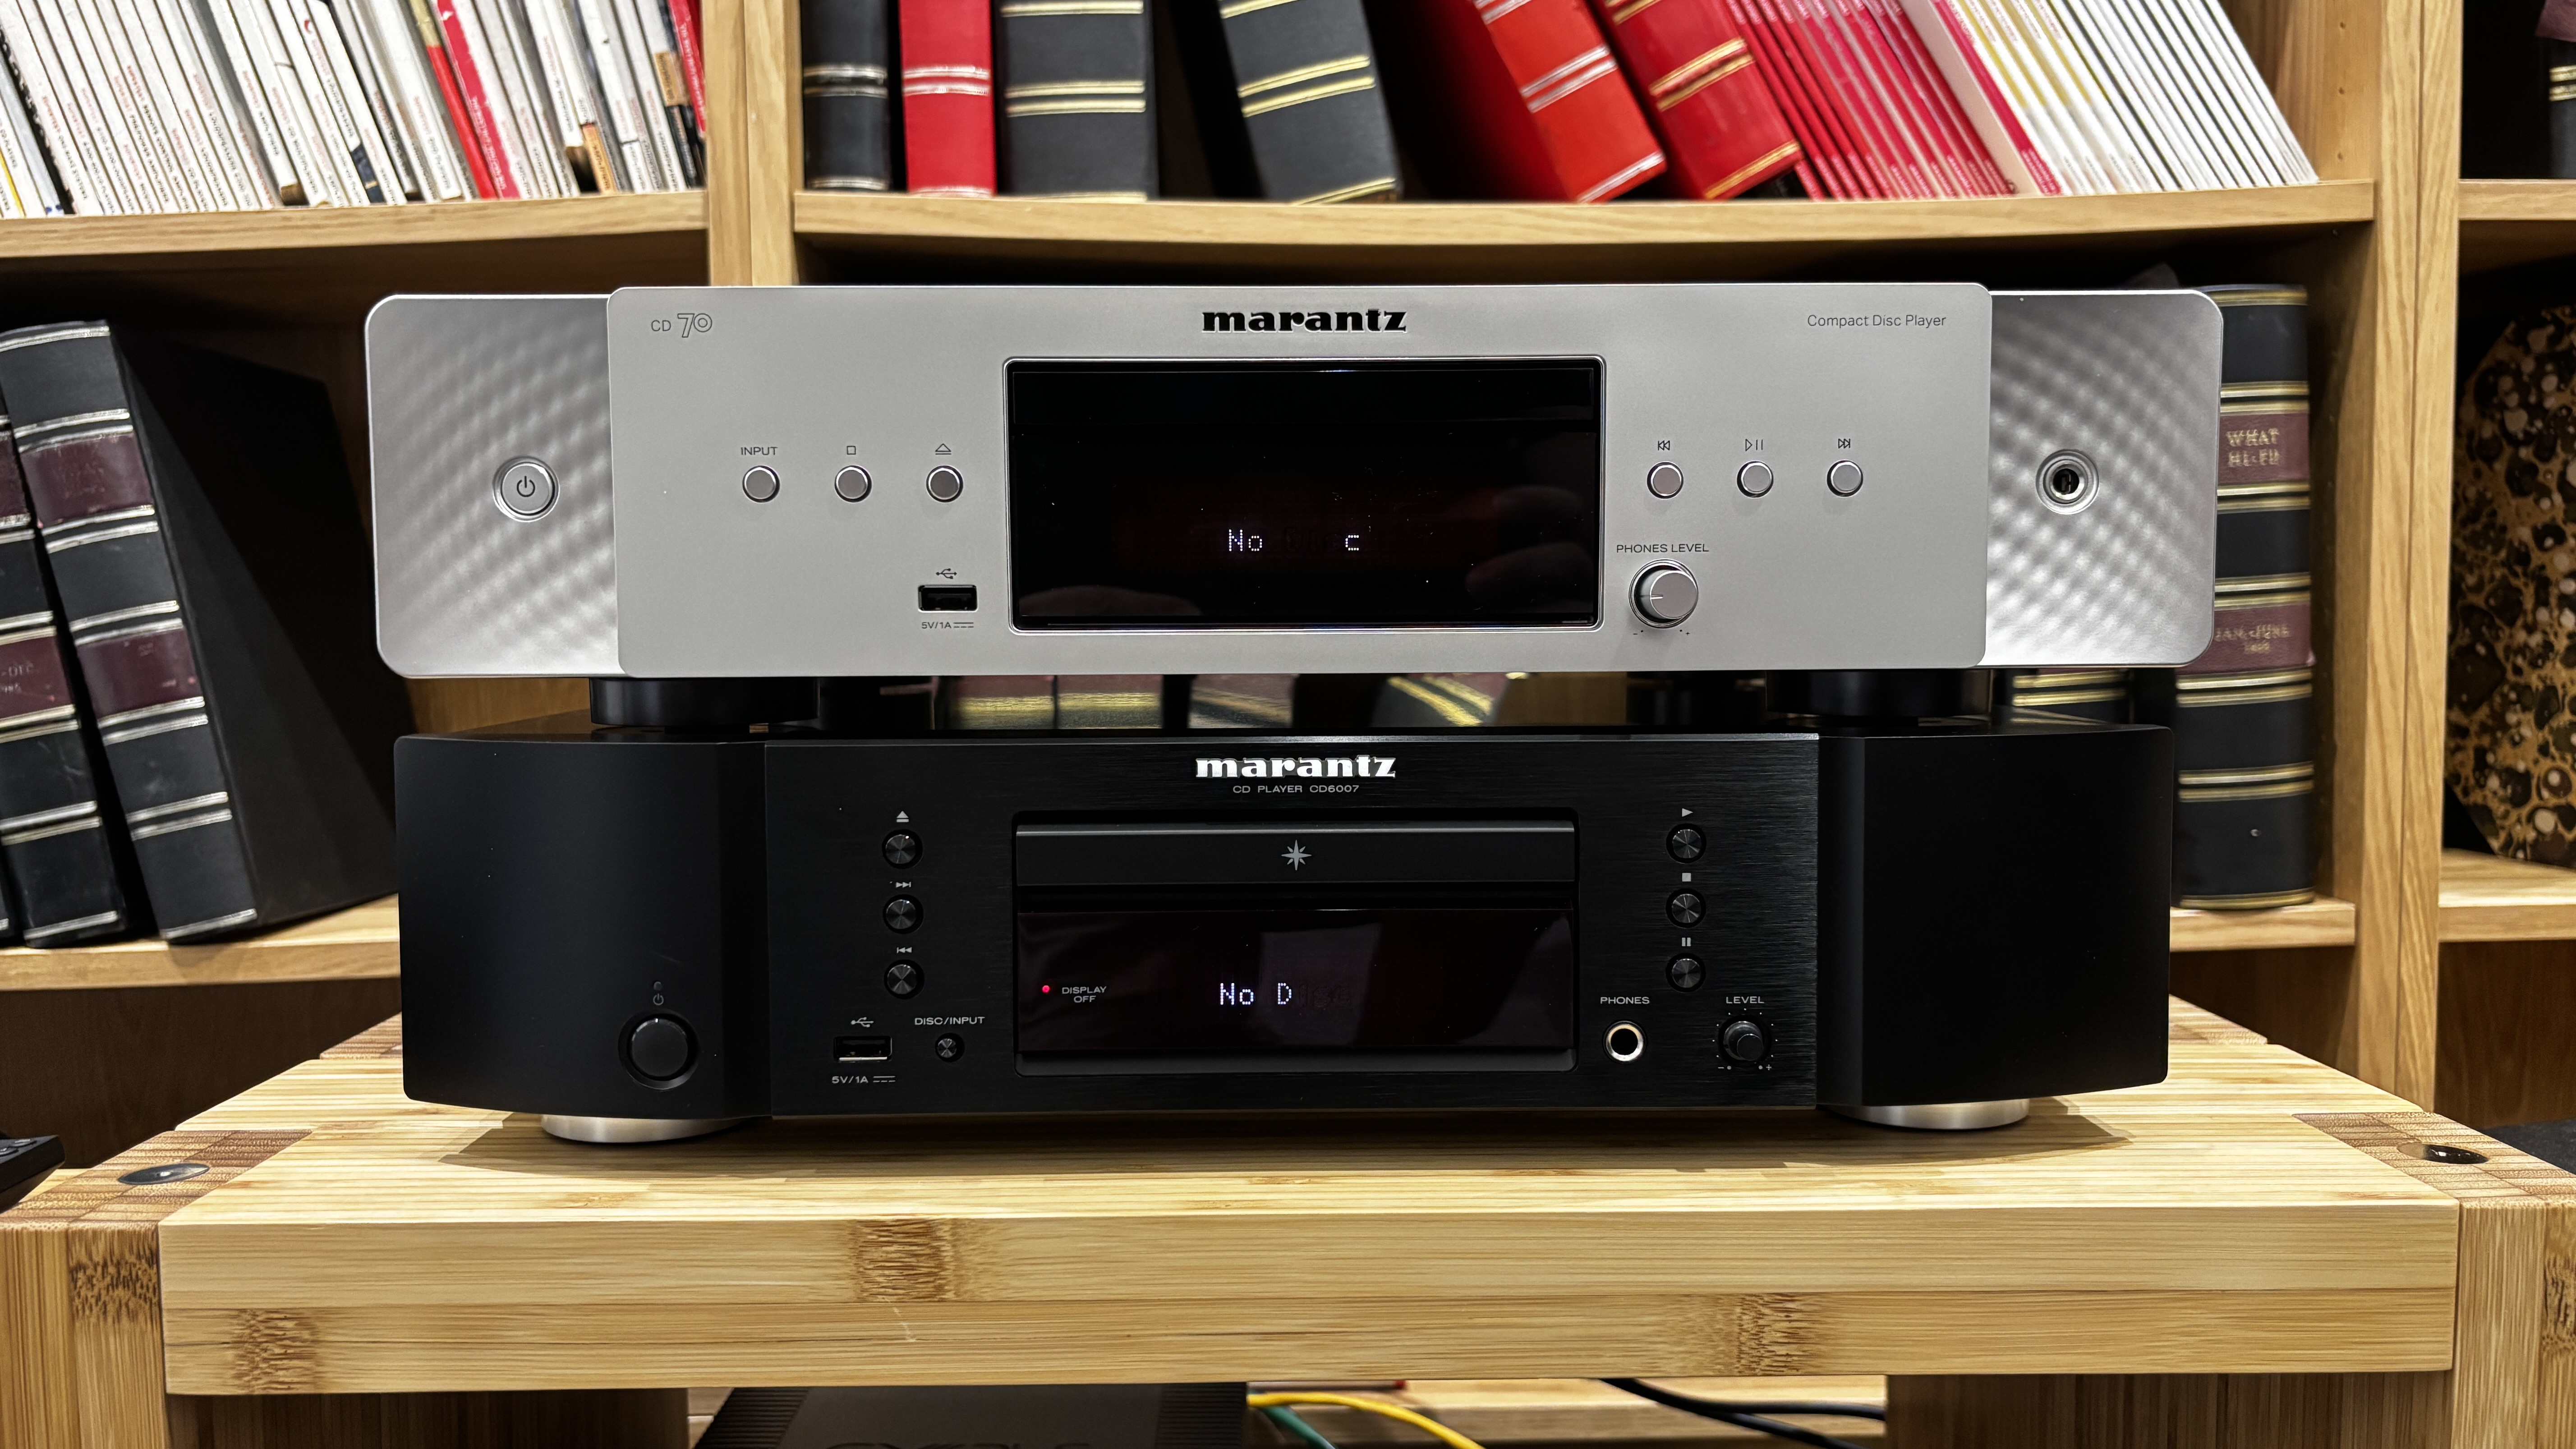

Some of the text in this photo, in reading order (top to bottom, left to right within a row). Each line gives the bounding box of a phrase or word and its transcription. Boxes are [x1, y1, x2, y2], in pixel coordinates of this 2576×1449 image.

[1202, 308, 1407, 332] marantz
[1807, 314, 1947, 329] Compact Disc Player
[650, 313, 713, 339] CD 70
[740, 446, 778, 456] INPUT
[1228, 529, 1263, 552] No
[1616, 543, 1710, 553] PHONES LEVEL
[921, 621, 952, 630] 5V/1A
[1196, 756, 1396, 778] marantz
[1232, 784, 1360, 794] CD PLAYER CD6007
[1061, 985, 1107, 995] DISPLAY
[1219, 982, 1254, 1006] No
[1073, 995, 1097, 1003] OFF
[1600, 996, 1650, 1005] PHONES
[1725, 996, 1765, 1004] LEVEL
[914, 1016, 985, 1026] DISC/INPUT
[831, 1075, 869, 1084] 5V/1A
